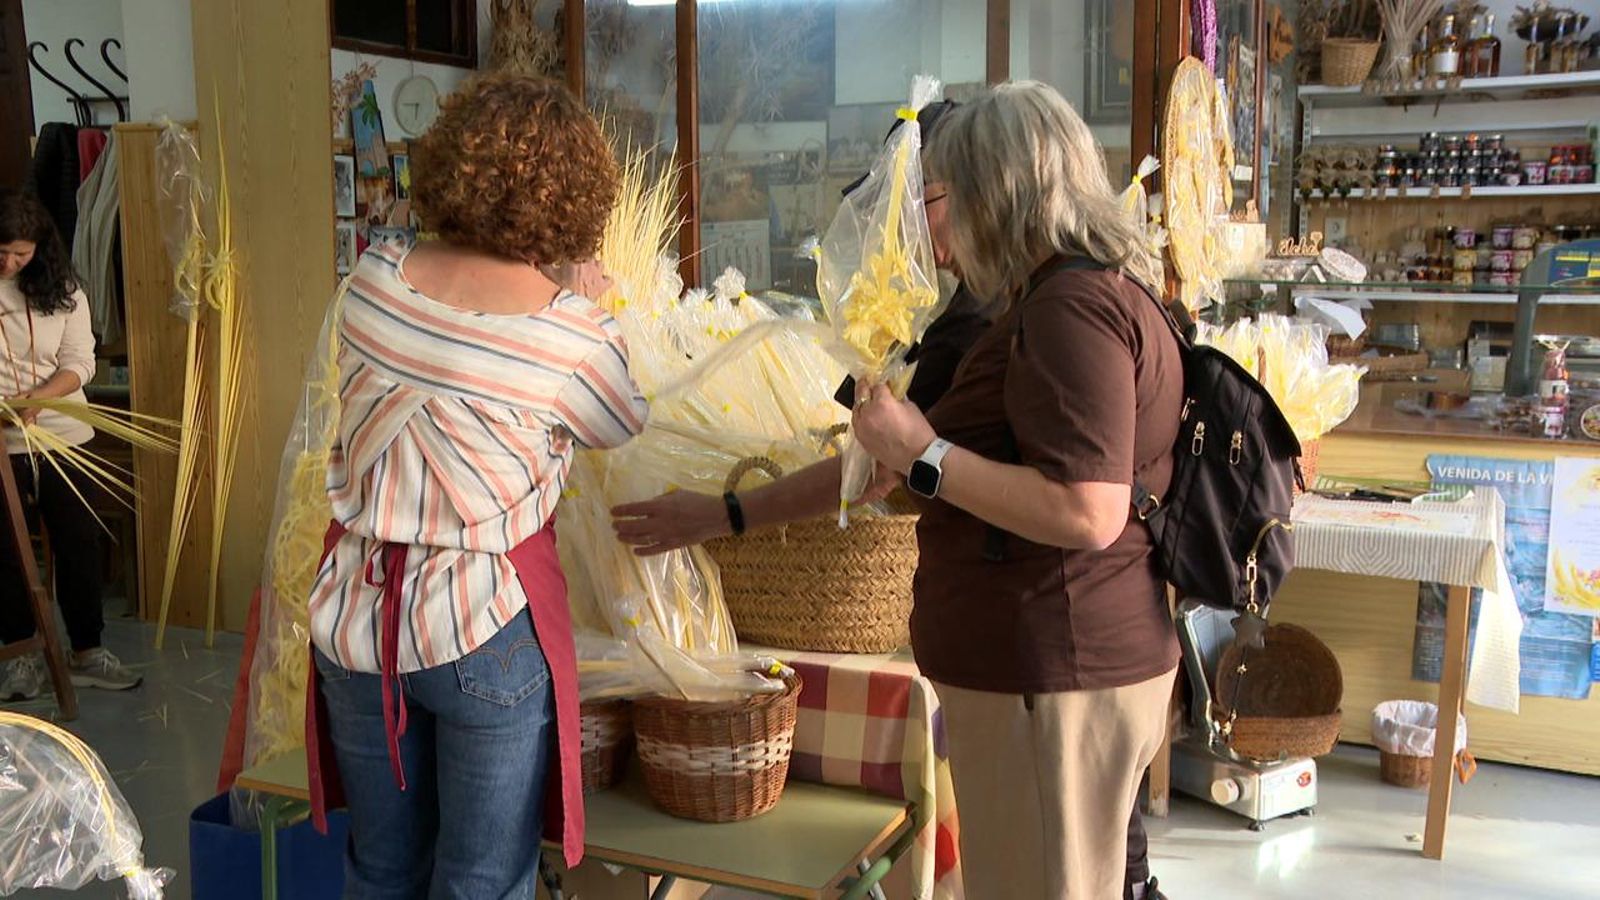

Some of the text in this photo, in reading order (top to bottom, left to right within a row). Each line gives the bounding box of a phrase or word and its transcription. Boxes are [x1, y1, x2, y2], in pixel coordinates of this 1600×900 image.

[1438, 465, 1491, 481] VENIDA
[1494, 469, 1515, 482] DE
[1517, 472, 1536, 485] LA
